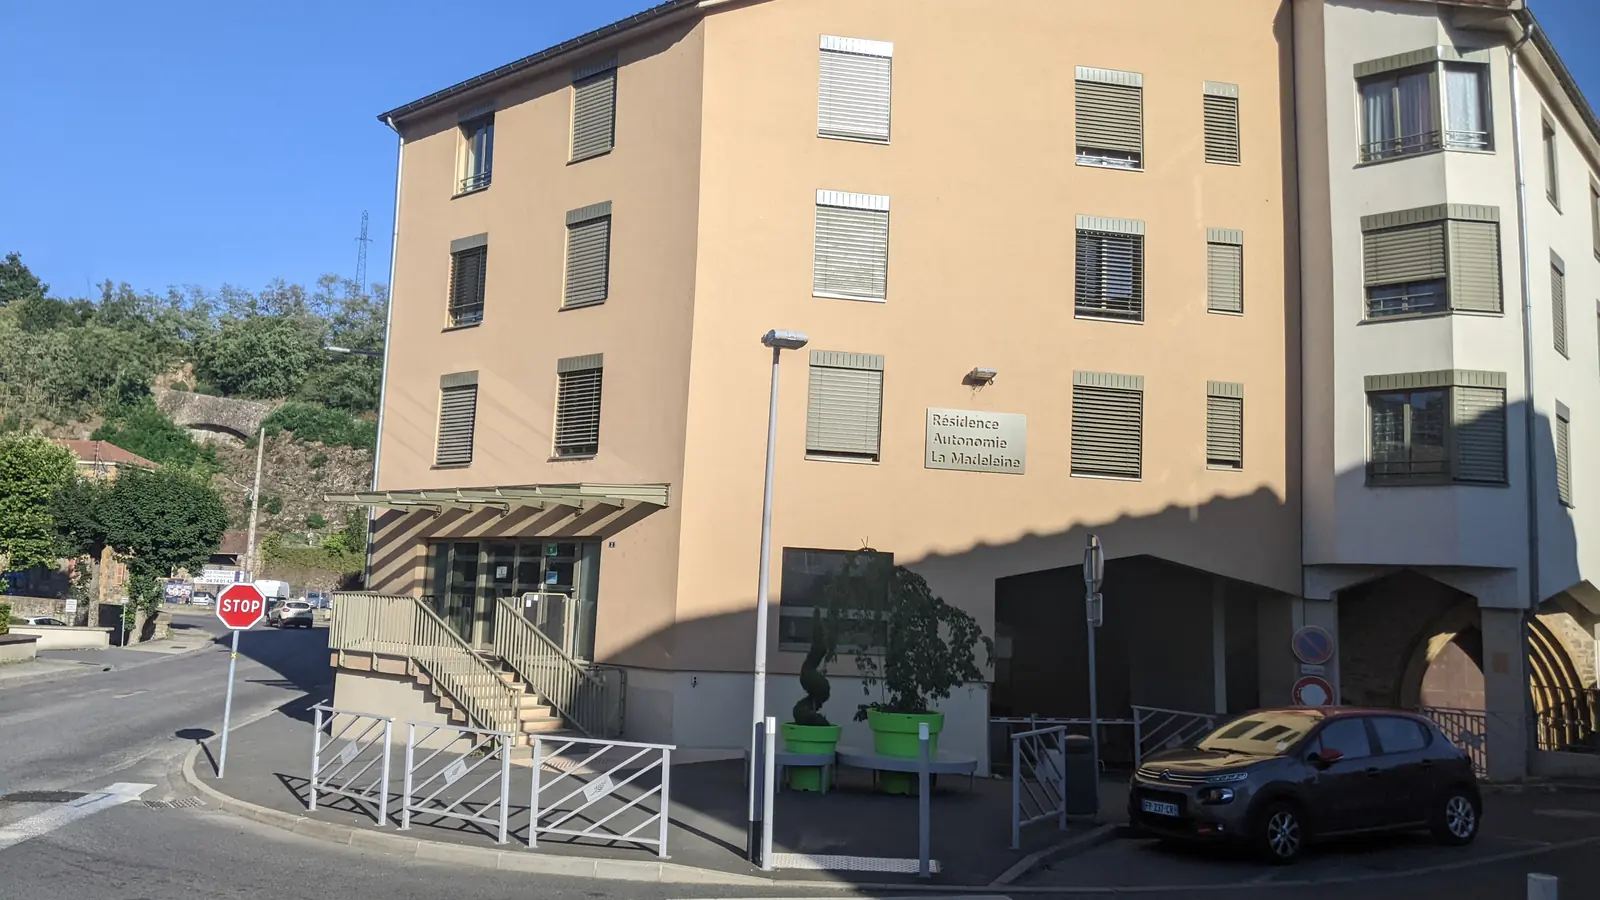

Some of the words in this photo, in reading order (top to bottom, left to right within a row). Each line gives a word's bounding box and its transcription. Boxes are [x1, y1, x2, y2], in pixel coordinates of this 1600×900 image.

[933, 413, 999, 430] Résidence
[933, 432, 1007, 449] Autonomie
[931, 451, 945, 463] La
[951, 452, 1020, 468] Madeleine
[222, 598, 260, 613] STOP
